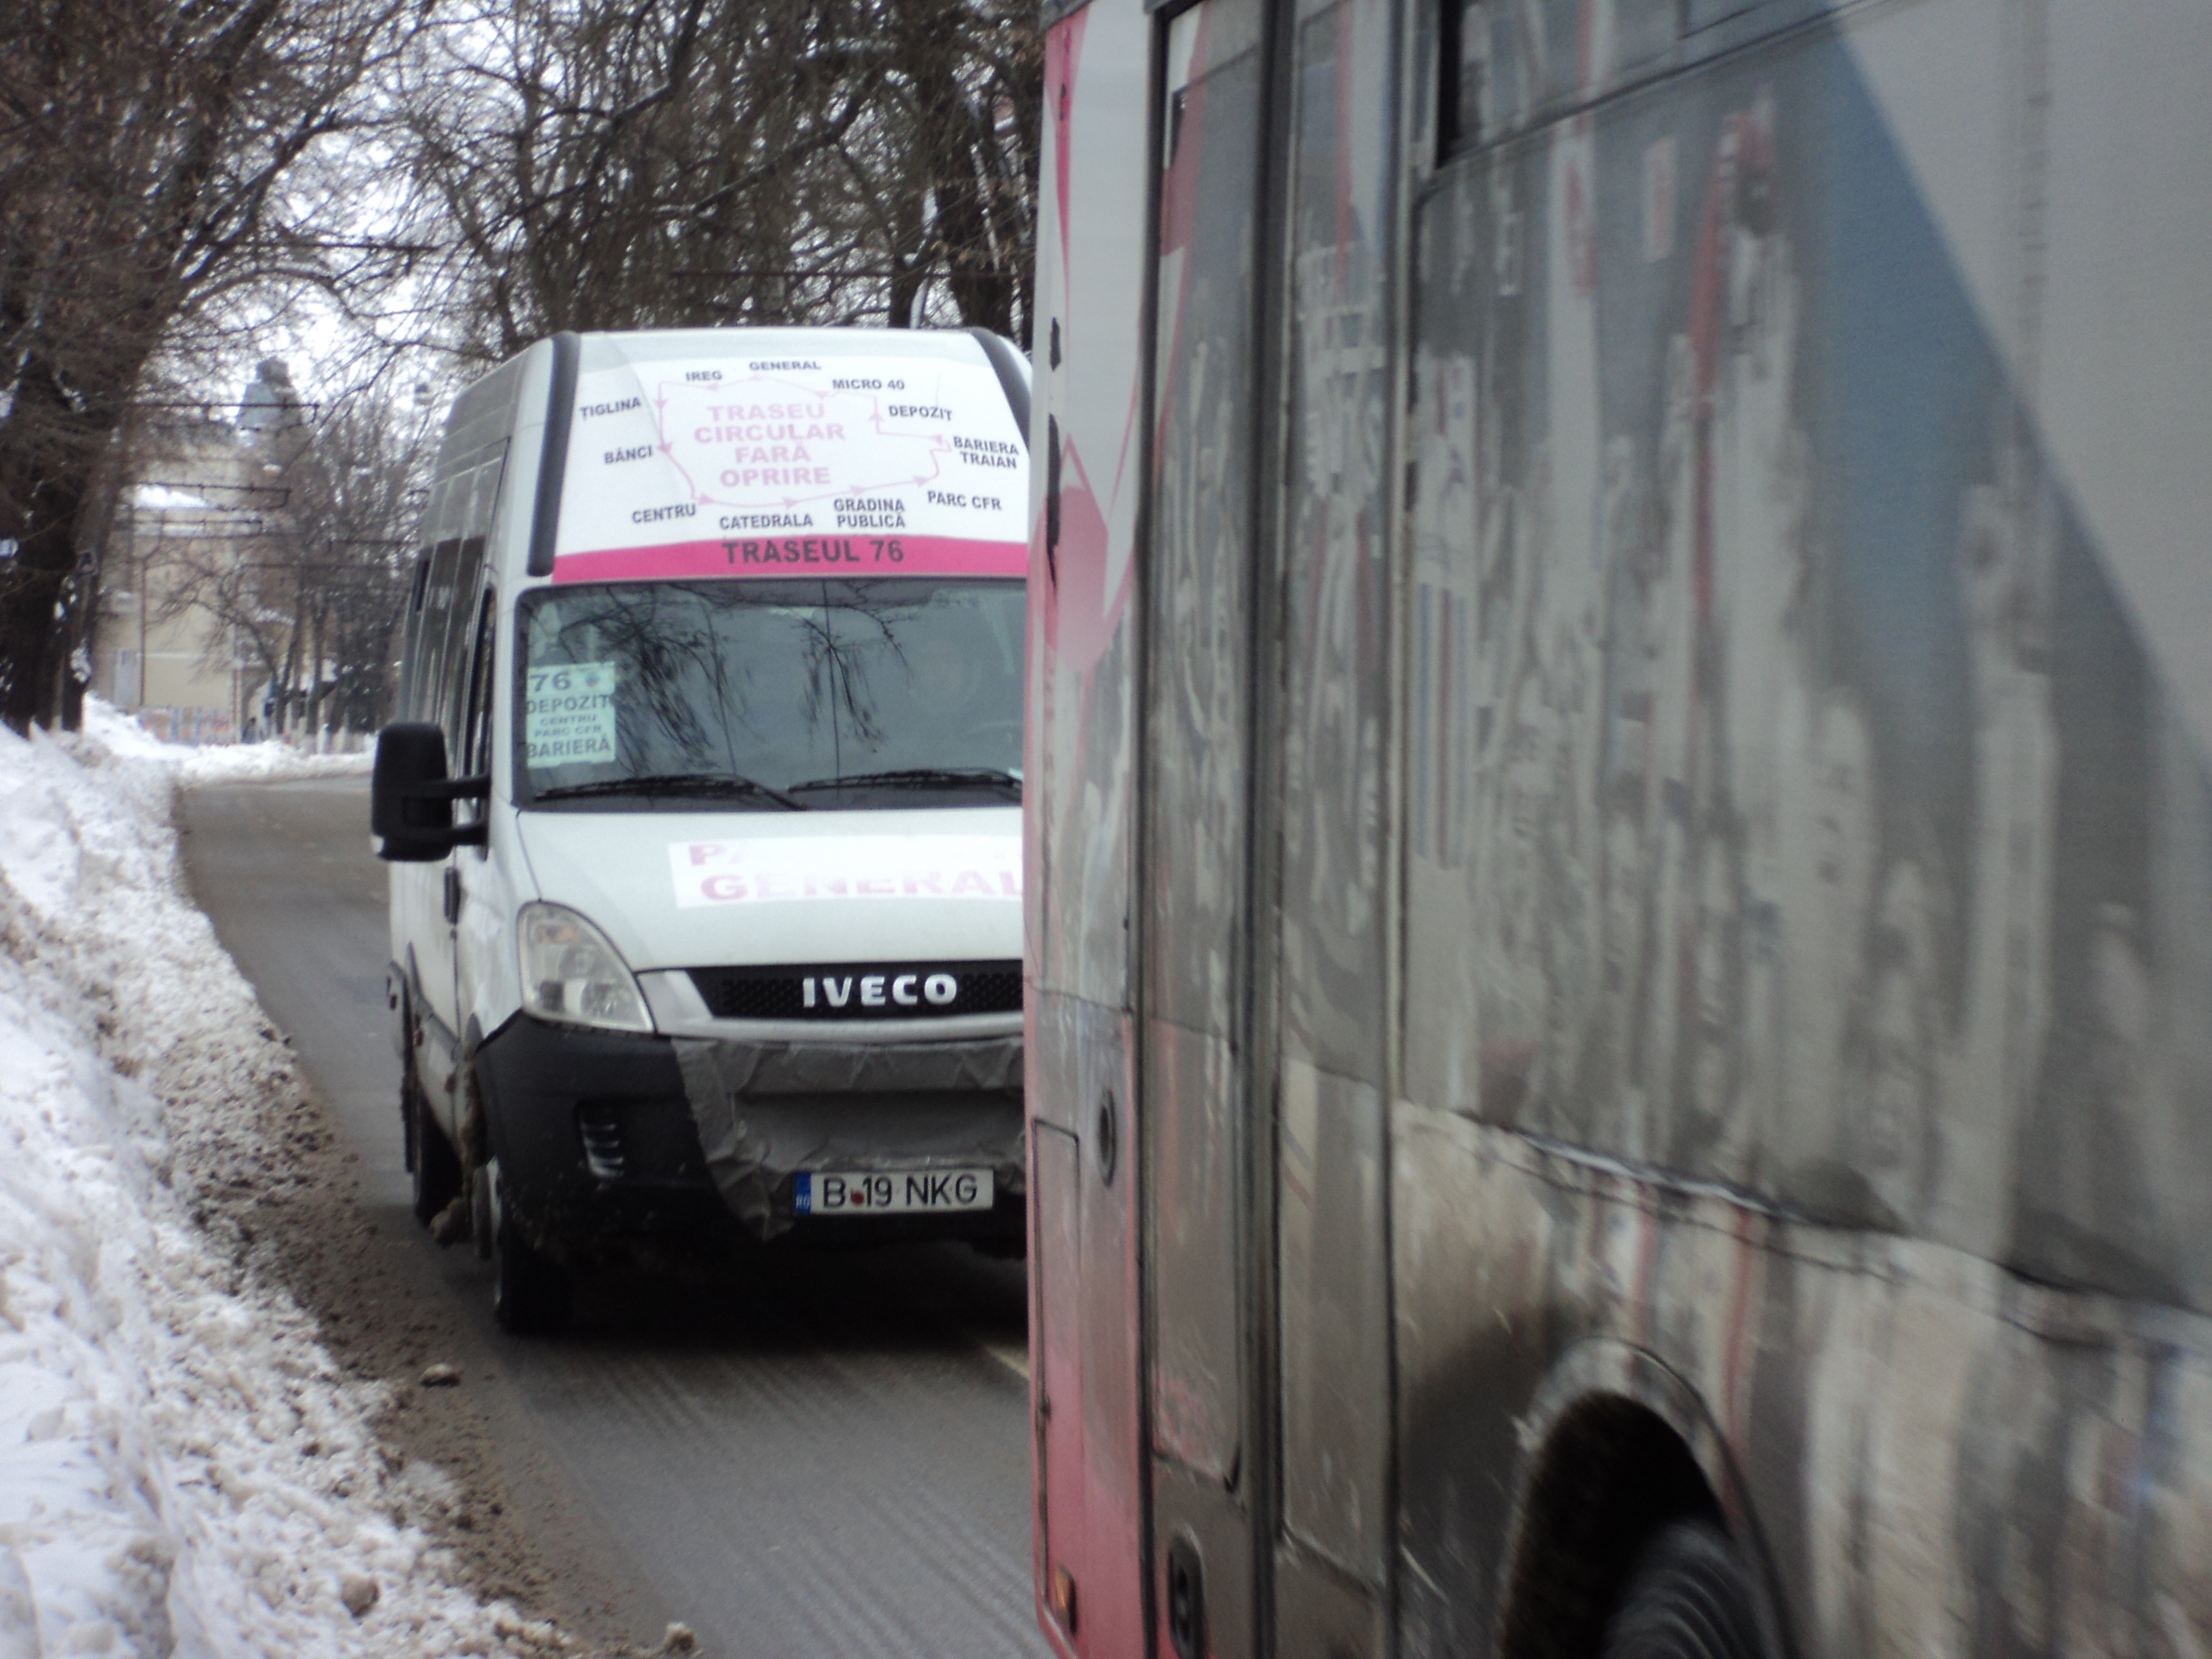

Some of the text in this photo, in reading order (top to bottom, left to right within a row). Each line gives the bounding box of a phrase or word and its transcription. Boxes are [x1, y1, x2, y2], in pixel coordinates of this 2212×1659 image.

[749, 360, 822, 371] GENERAL
[686, 371, 723, 382] IREG
[833, 379, 905, 390] MICRO 40
[706, 403, 825, 421] TRASEU
[888, 405, 953, 421] DEPOZIT
[693, 422, 846, 444] CIRCULAR
[953, 435, 1019, 456] BARIERA
[959, 451, 1017, 469] TRAIAN
[719, 466, 831, 488] OPRIRE
[927, 491, 1002, 510] PARC CFR
[632, 503, 696, 524] CENTRU
[719, 513, 813, 530] CATEDRALA
[721, 539, 904, 564] TRASEUL 76
[530, 670, 571, 692] 76
[528, 695, 608, 714] DEPOZIT
[802, 973, 958, 1008] IVECO
[823, 1177, 847, 1208] B
[906, 1173, 977, 1206] NKG
